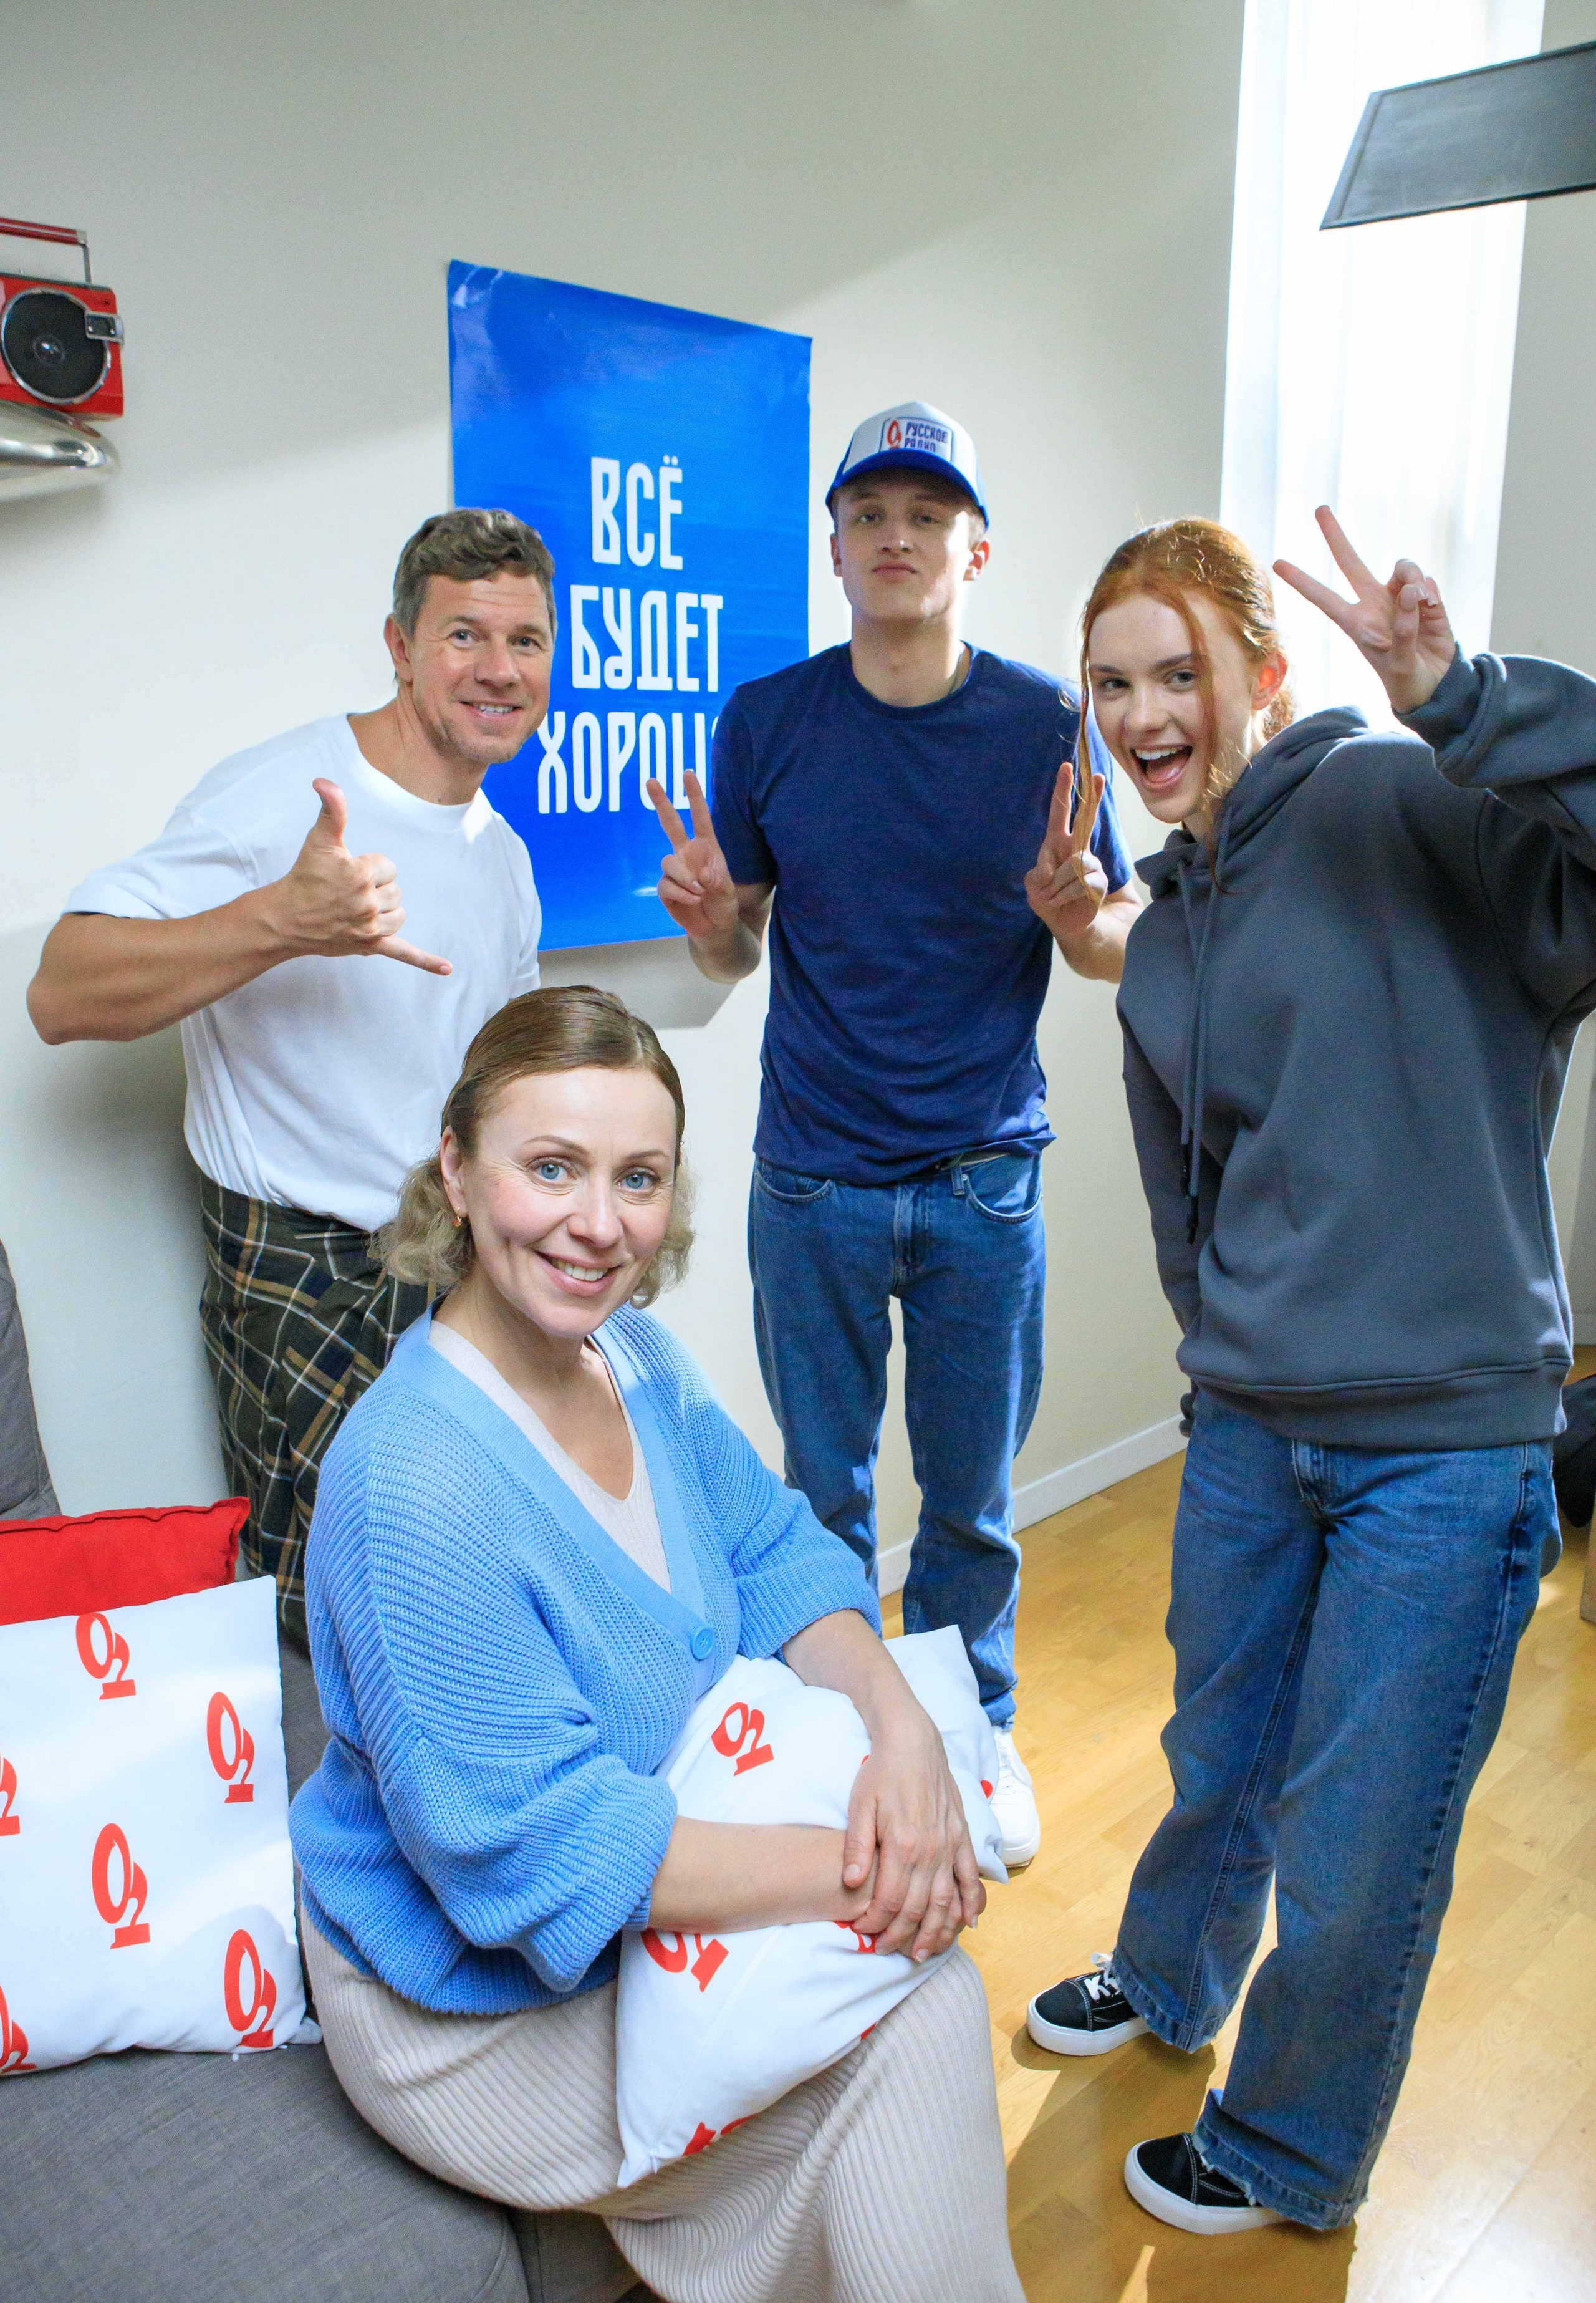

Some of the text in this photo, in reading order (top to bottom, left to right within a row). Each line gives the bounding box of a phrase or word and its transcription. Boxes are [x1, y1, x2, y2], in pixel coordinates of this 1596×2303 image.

[905, 422, 948, 443] РУССКОЕ
[590, 455, 683, 570] ВСЁ
[570, 584, 724, 692] БУДЕТ
[537, 710, 719, 814] ХОРОШ
